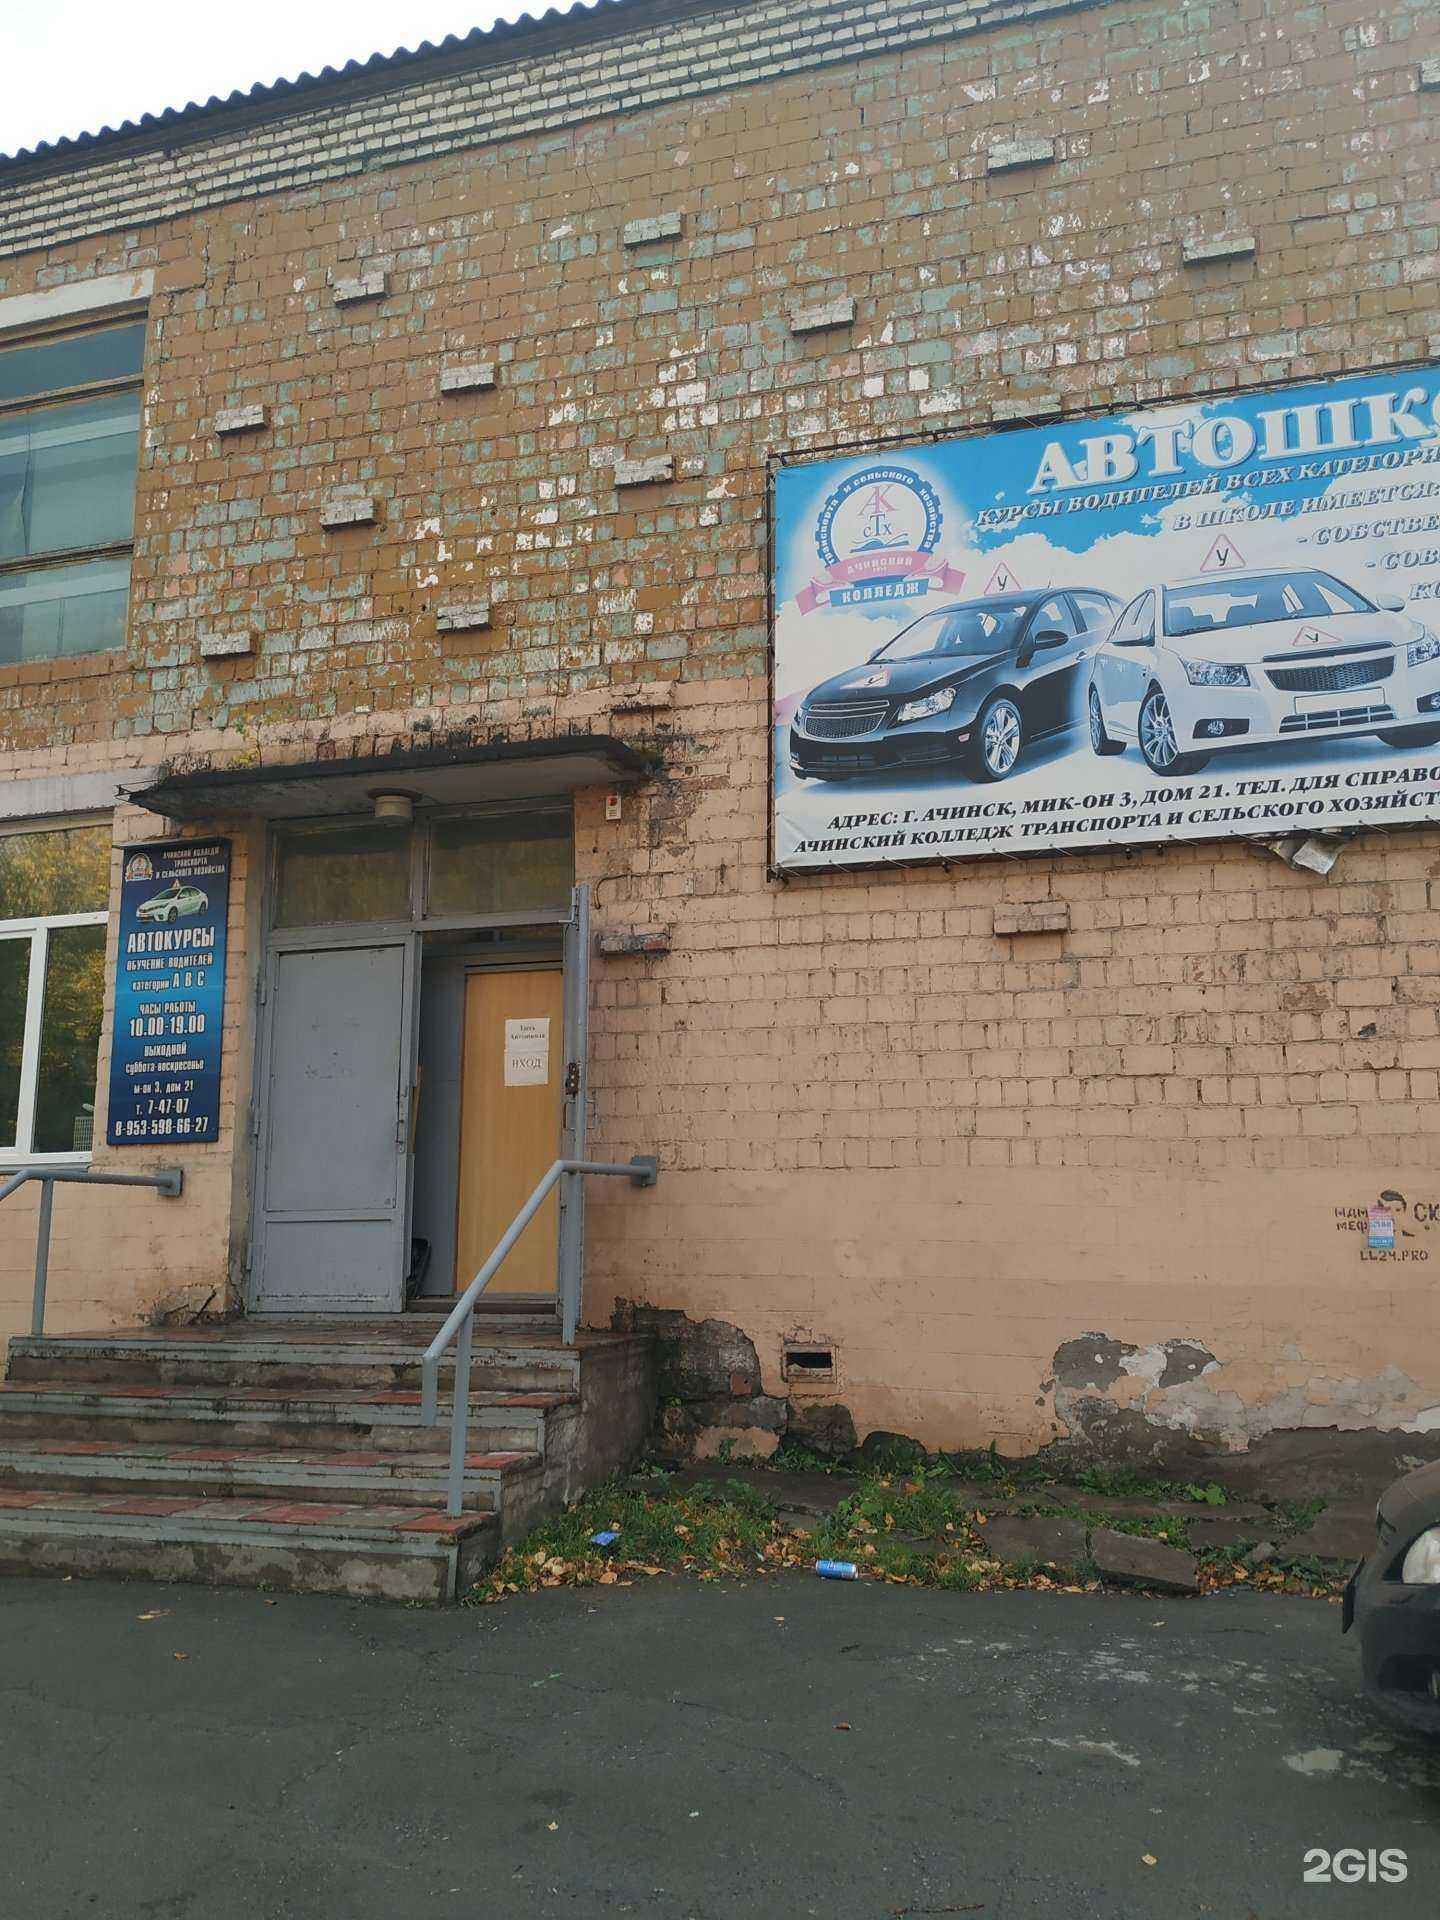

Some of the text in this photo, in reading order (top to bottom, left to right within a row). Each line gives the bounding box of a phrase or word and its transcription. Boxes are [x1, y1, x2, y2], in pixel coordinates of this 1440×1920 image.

[975, 499, 1064, 527] КУРСЫ
[1066, 472, 1221, 513] ВОДИТЕЛЕЙ
[1223, 464, 1297, 491] ВСЕХ
[1173, 512, 1192, 531] В
[1195, 501, 1296, 528] ШКОЛЕ
[841, 581, 920, 604] КОЛЛЕДЖ
[827, 811, 898, 831] АДРЕС:
[902, 810, 919, 823] Г.
[922, 802, 1016, 824] АЧИНСК,
[1021, 792, 1114, 814] МИК-ОН
[1119, 794, 1138, 809] 3,
[1140, 786, 1193, 807] ДОМ
[1199, 783, 1230, 799] 21.
[1236, 777, 1286, 797] ТЕЛ.
[1289, 772, 1340, 794] ДЛЯ
[792, 829, 906, 853] АЧИНСКИЙ
[910, 823, 1013, 845] КОЛЛЕДЖ
[1020, 811, 1163, 838] ТРАНСПОРТА
[1166, 811, 1184, 825] И
[1188, 798, 1325, 823] СЕЛЬСКОГО
[127, 926, 215, 953] АВТОКУРСЫ
[126, 952, 213, 971] ОБУЧЕНИЕ ВОДИТЕЛЕЙ
[132, 979, 170, 993] категории
[140, 1000, 196, 1015] ЧАСЫ РАБОТЫ
[130, 1014, 205, 1036] 10.00-19.00
[144, 1042, 187, 1057] ВЫХОДНОЙ
[125, 1059, 204, 1075] суббота-воскресенье
[166, 1082, 181, 1094] дом
[184, 1080, 193, 1091] 21
[148, 1098, 189, 1115] 7-47-07
[115, 1116, 208, 1137] 8-953-598-66-27
